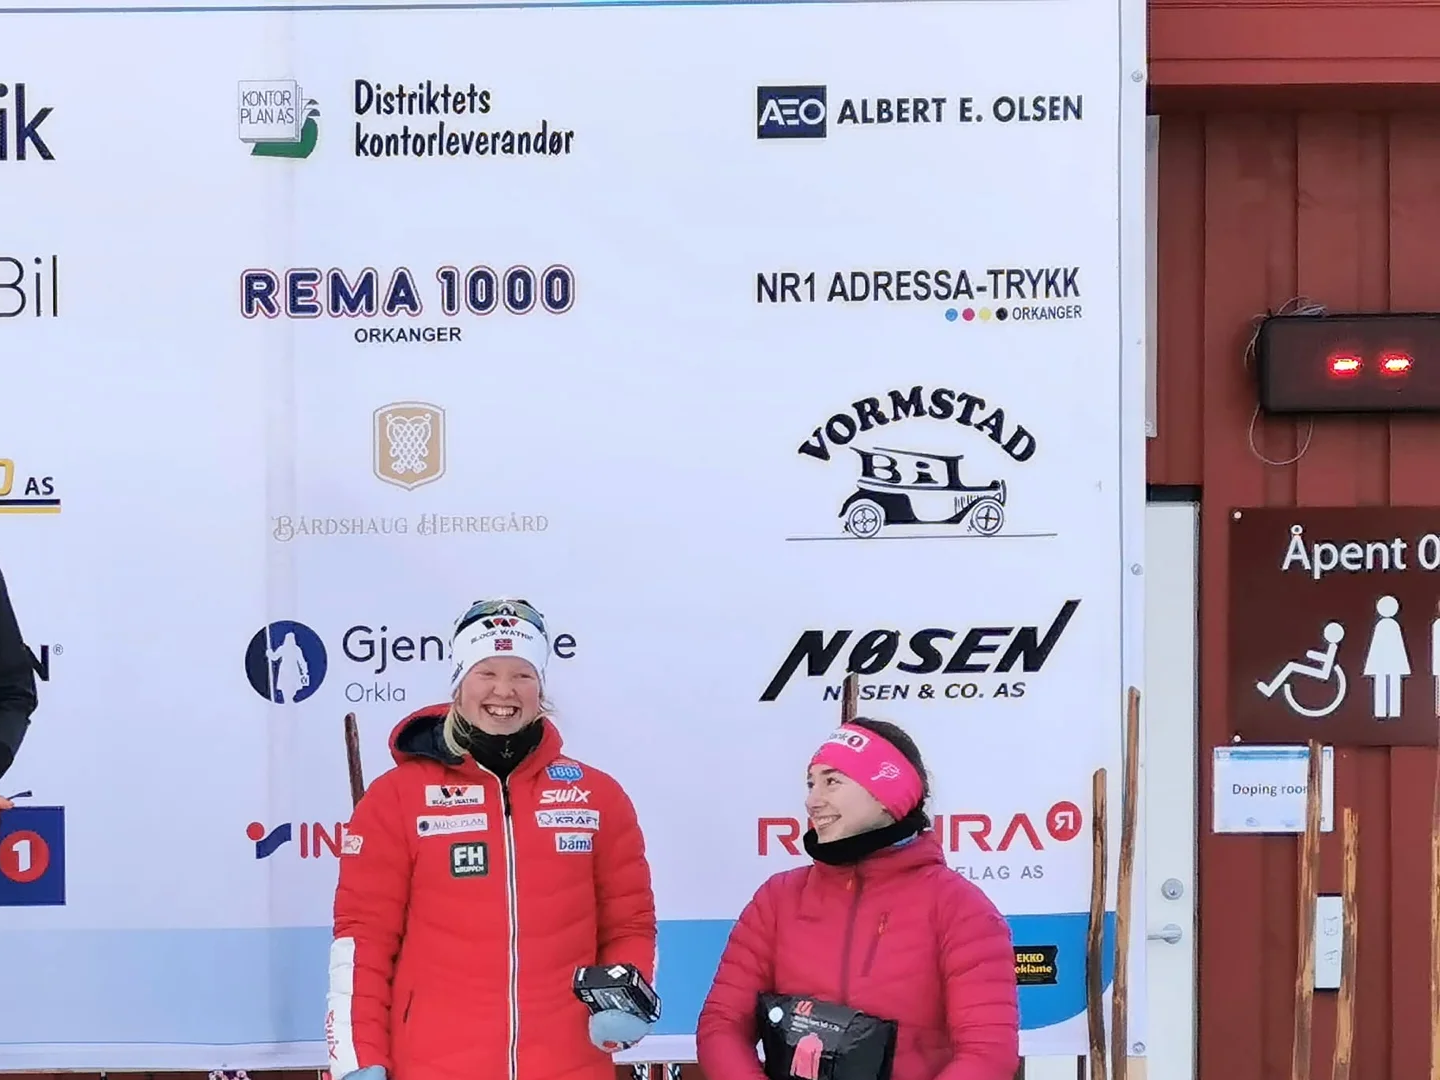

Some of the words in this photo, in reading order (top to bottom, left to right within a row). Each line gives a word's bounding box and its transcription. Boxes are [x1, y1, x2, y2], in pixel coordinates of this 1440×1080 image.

[242, 90, 291, 107] KONTOR
[355, 79, 491, 116] Distriktets
[241, 108, 273, 124] PLAN
[759, 98, 825, 126] AEO
[837, 97, 947, 124] ALBERT
[960, 96, 983, 123] E.
[993, 95, 1083, 122] OLSEN
[355, 120, 575, 157] kontorleverandør
[241, 267, 423, 319] REMA
[436, 264, 575, 316] 1000
[757, 272, 817, 303] NR1
[828, 267, 1080, 301] ADRESSA-TRYKK
[1012, 305, 1082, 321] ORKANGER
[354, 327, 462, 343] ORKANGER
[798, 385, 1036, 462] VORMSTAD
[25, 477, 54, 496] AS
[1282, 525, 1407, 579] Åpent
[759, 600, 1082, 702] NØSEN
[345, 681, 406, 703] Orkla
[822, 684, 910, 701] NSEN
[918, 684, 935, 699] &
[944, 683, 984, 699] CO.
[993, 682, 1026, 698] AS
[1232, 783, 1277, 797] Doping
[555, 815, 597, 827] KRAFT
[12, 839, 31, 873] 1
[454, 846, 484, 866] FH
[1020, 865, 1044, 879] AS
[1014, 964, 1053, 974] eklame
